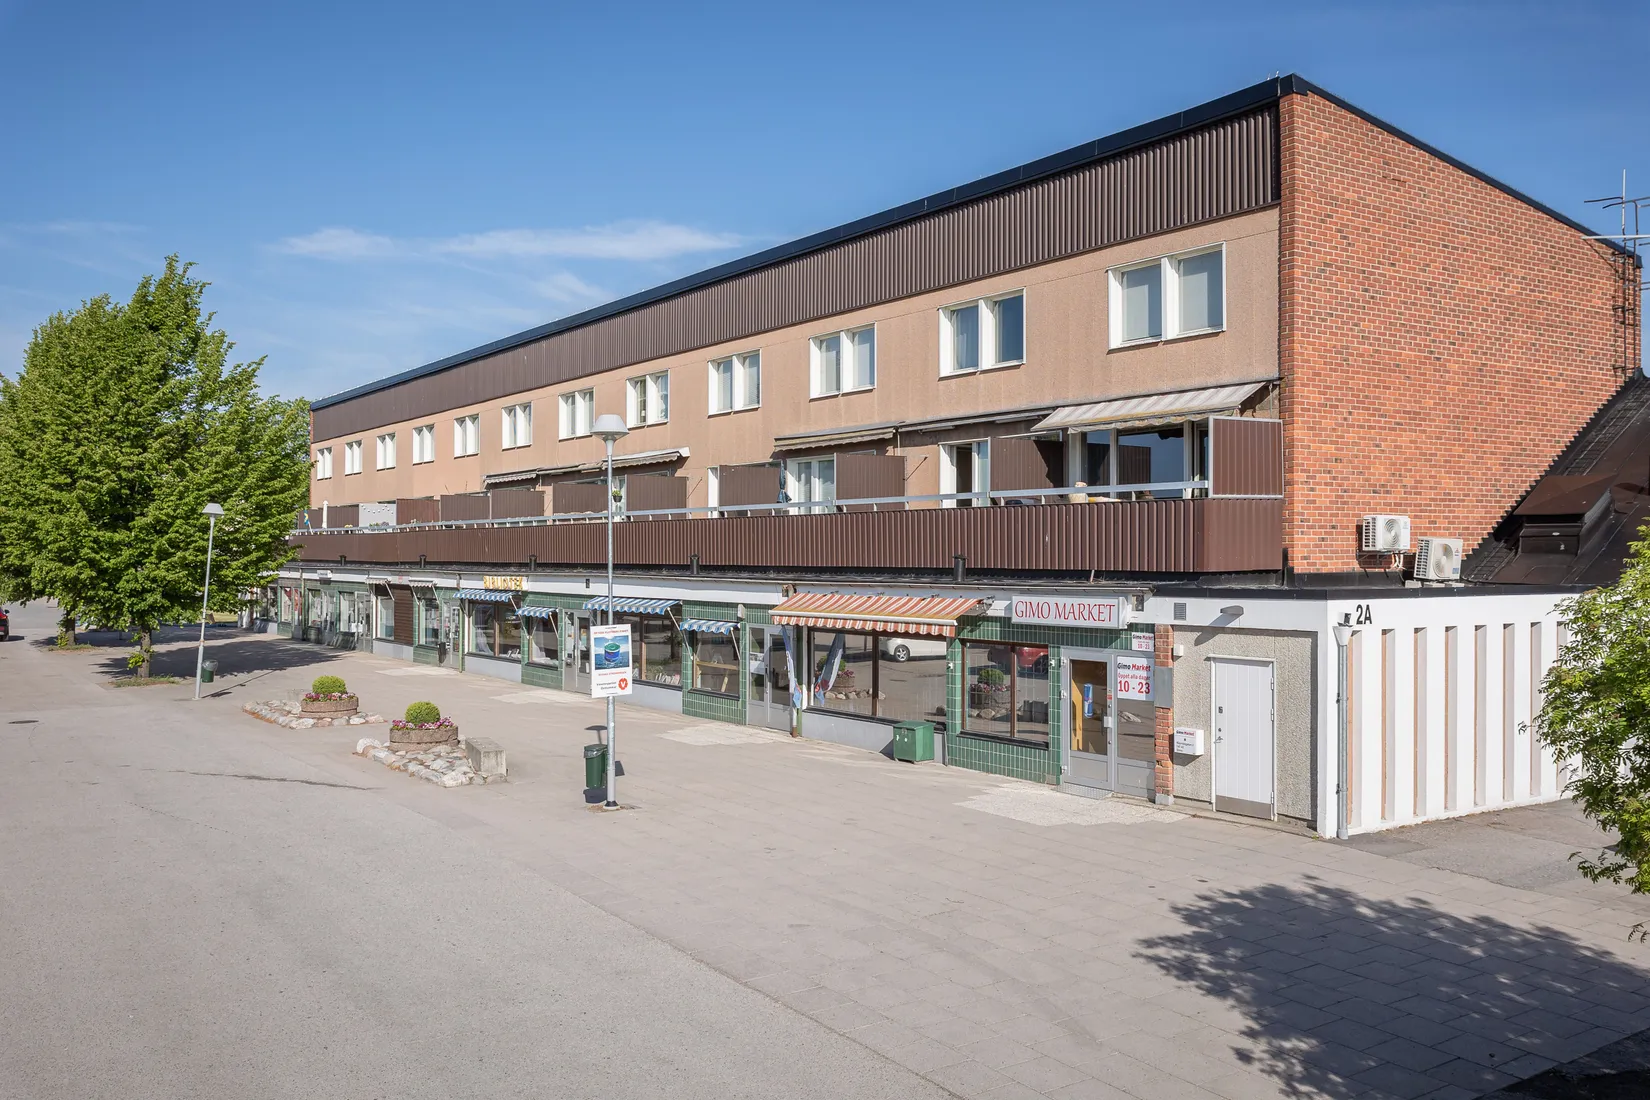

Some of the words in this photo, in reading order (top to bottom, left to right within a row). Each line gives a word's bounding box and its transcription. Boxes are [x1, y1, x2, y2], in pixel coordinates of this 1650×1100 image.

[1014, 600, 1051, 619] GIMO
[1054, 602, 1115, 622] MARKET
[1356, 604, 1372, 625] 2A
[1118, 680, 1130, 692] 10
[1137, 682, 1151, 694] 23
